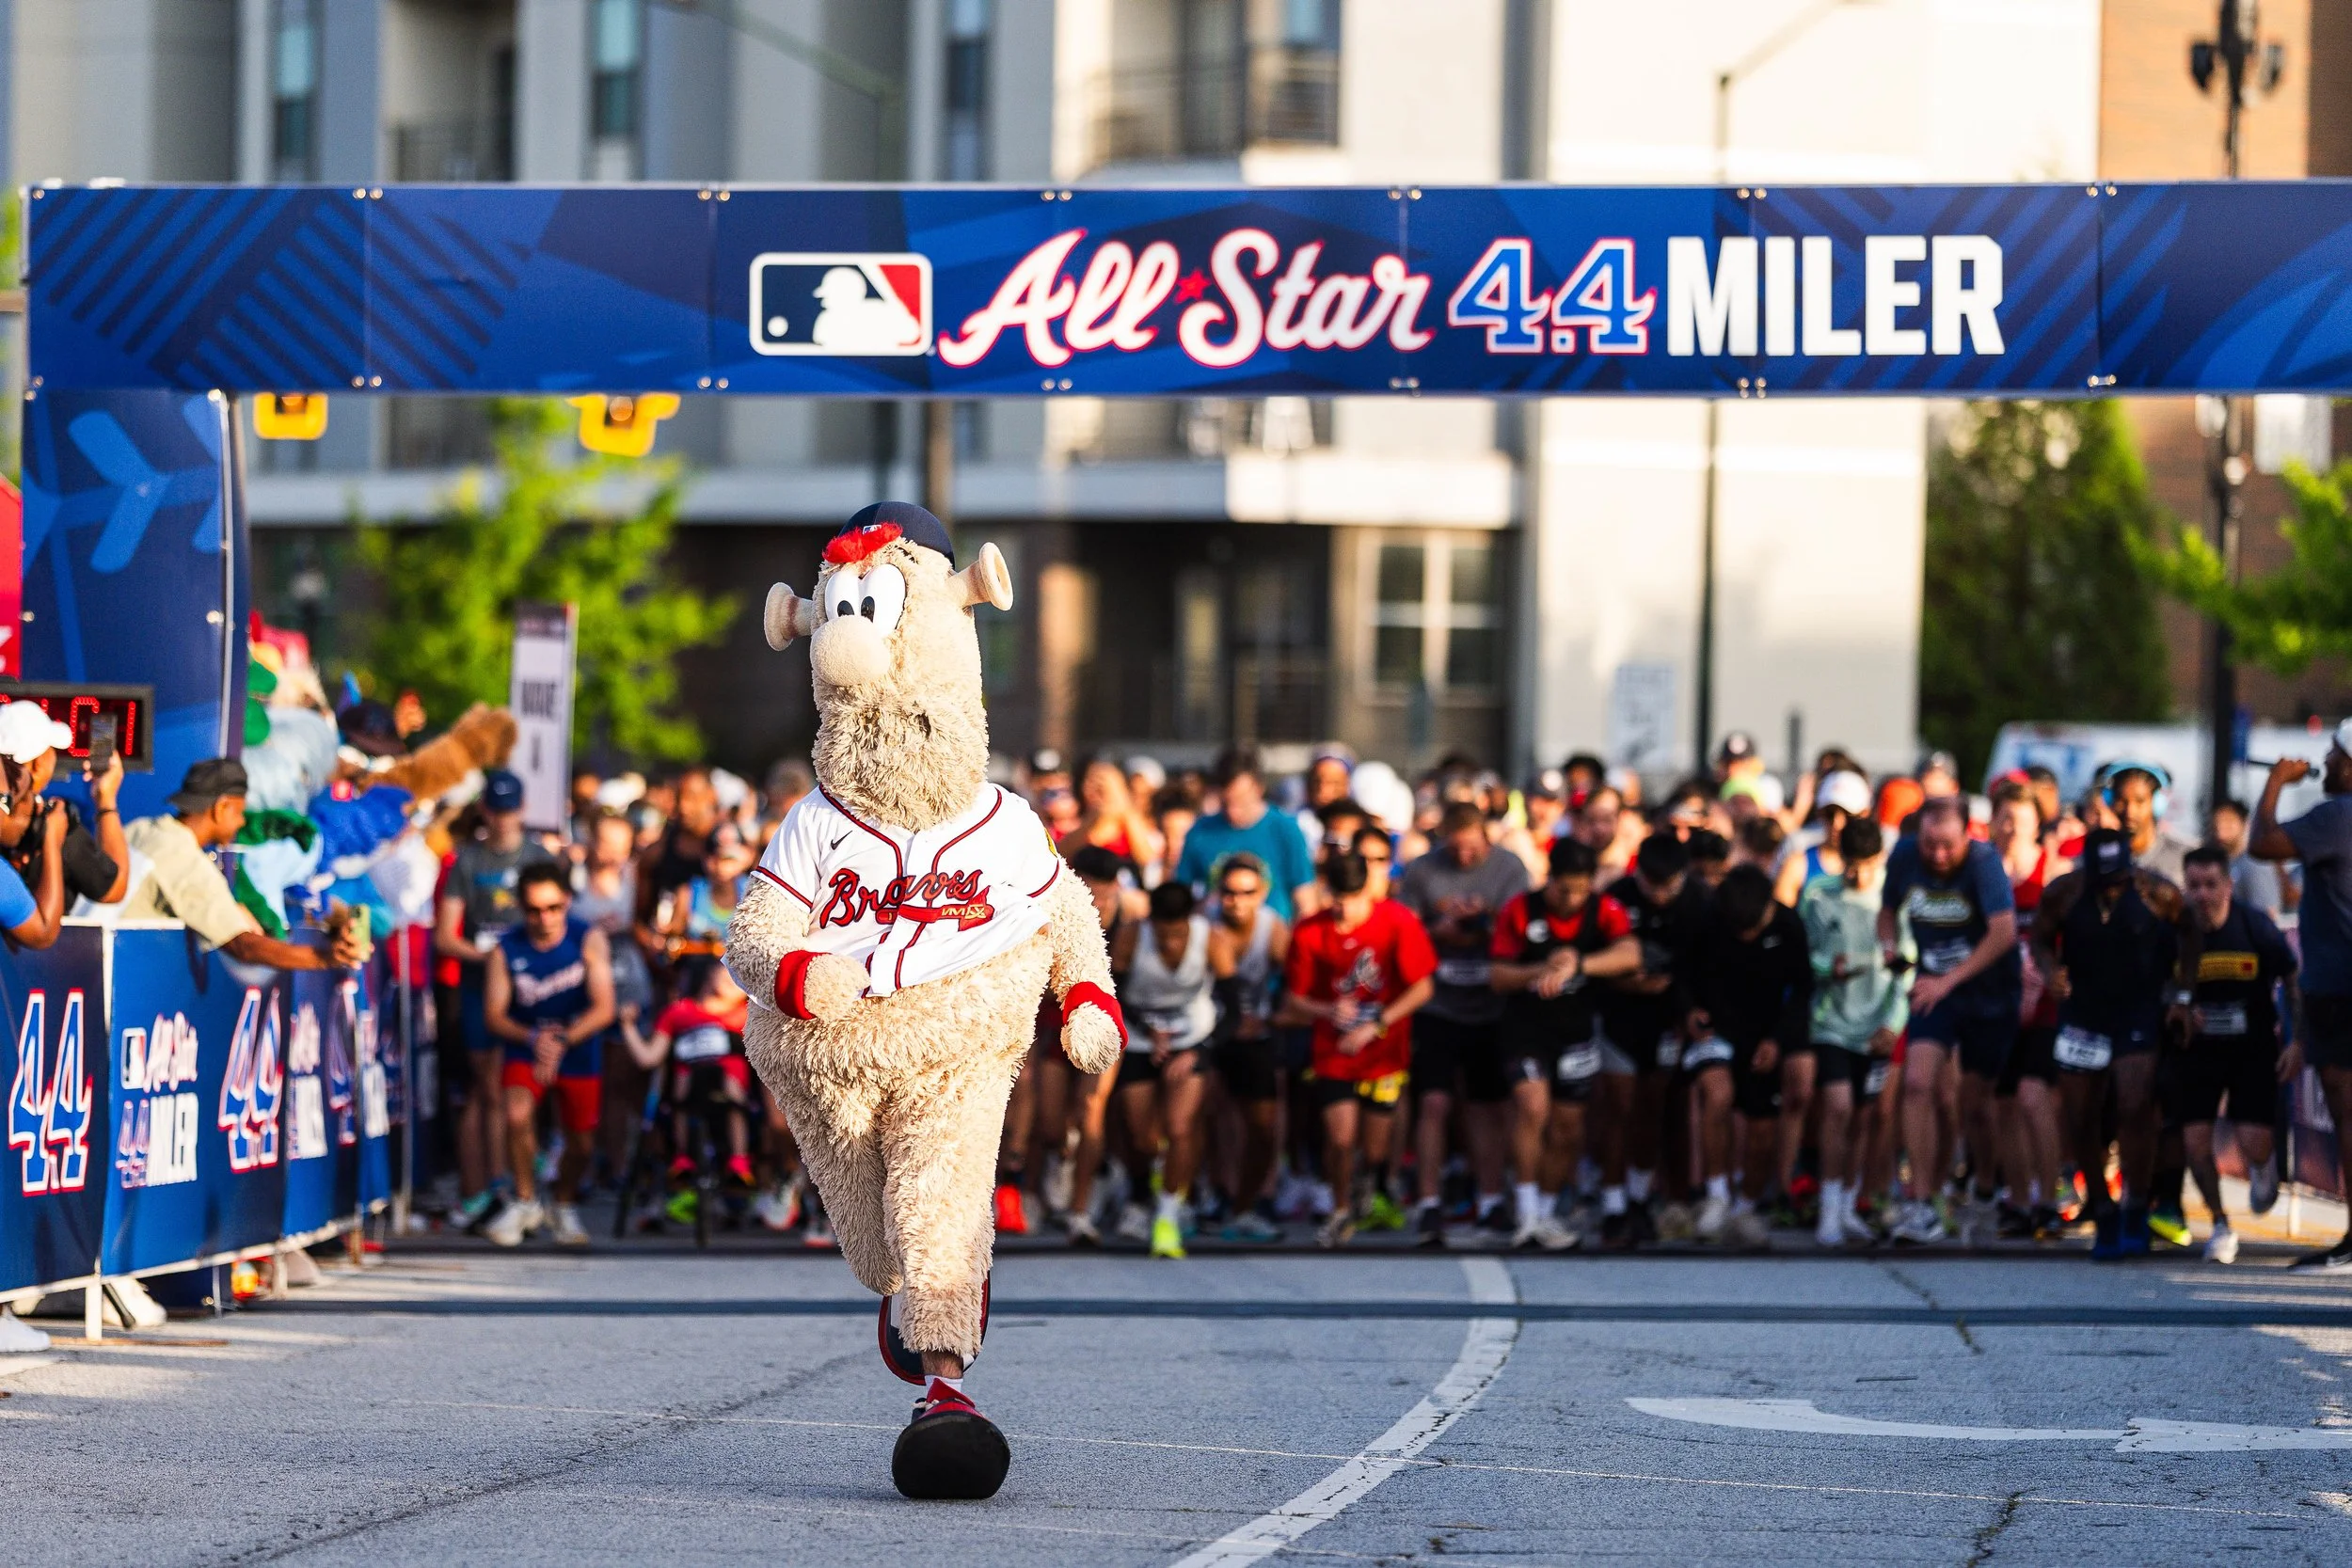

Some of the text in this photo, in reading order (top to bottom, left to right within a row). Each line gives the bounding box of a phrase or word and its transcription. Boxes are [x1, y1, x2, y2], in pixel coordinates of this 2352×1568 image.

[939, 228, 2006, 368] All Star 4.4 MILER
[819, 867, 984, 929] Braves
